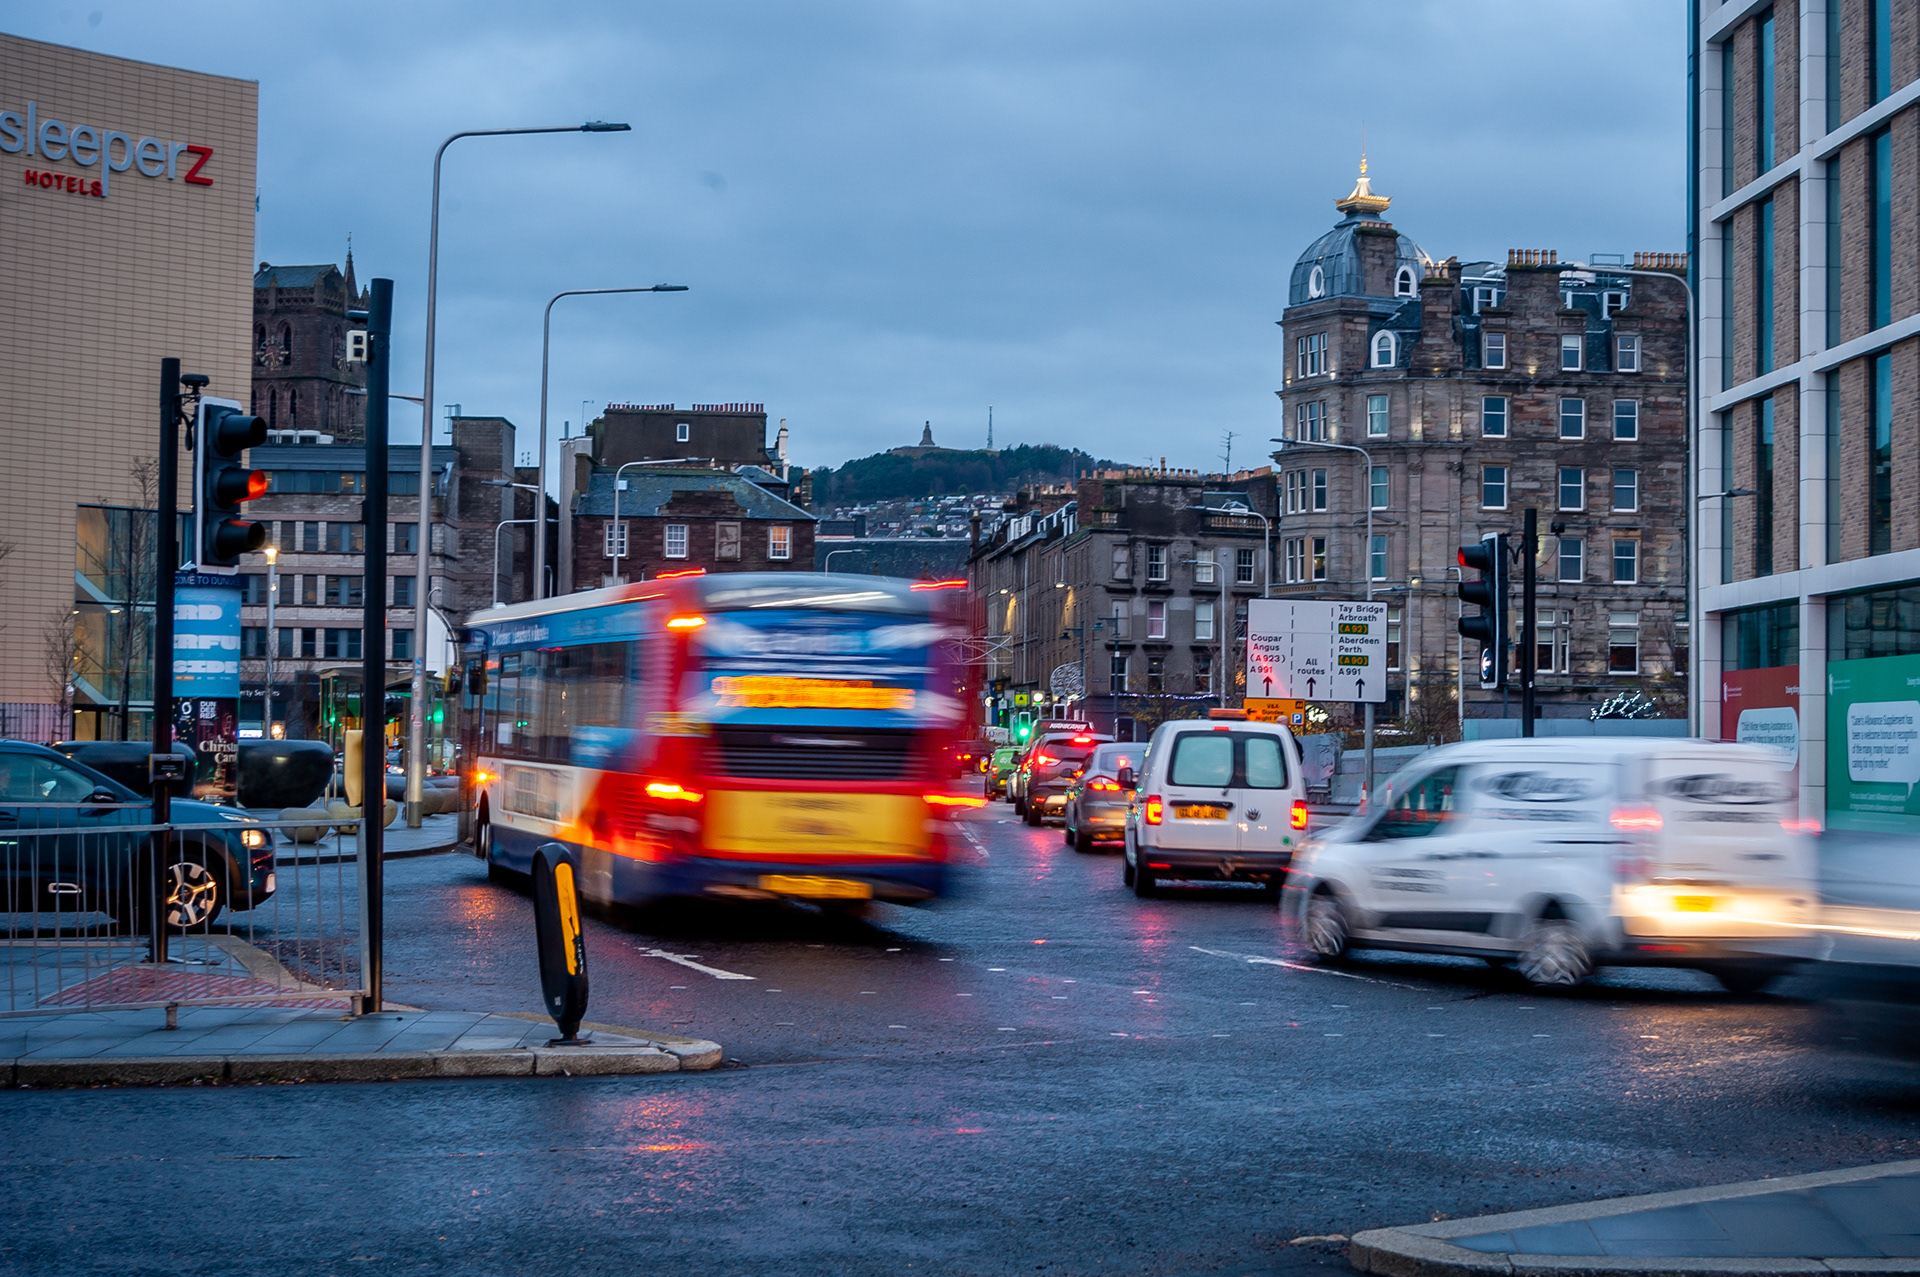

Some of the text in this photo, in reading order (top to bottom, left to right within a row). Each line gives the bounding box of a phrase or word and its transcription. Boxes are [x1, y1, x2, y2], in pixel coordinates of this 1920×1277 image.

[0, 102, 214, 197] sleeperz
[25, 170, 103, 196] HOTELS
[196, 576, 210, 585] TO
[1339, 605, 1384, 614] Tay Bridge
[1251, 634, 1282, 643] Coupar
[1339, 637, 1379, 645] Aberdeen
[1253, 644, 1280, 652] Angus
